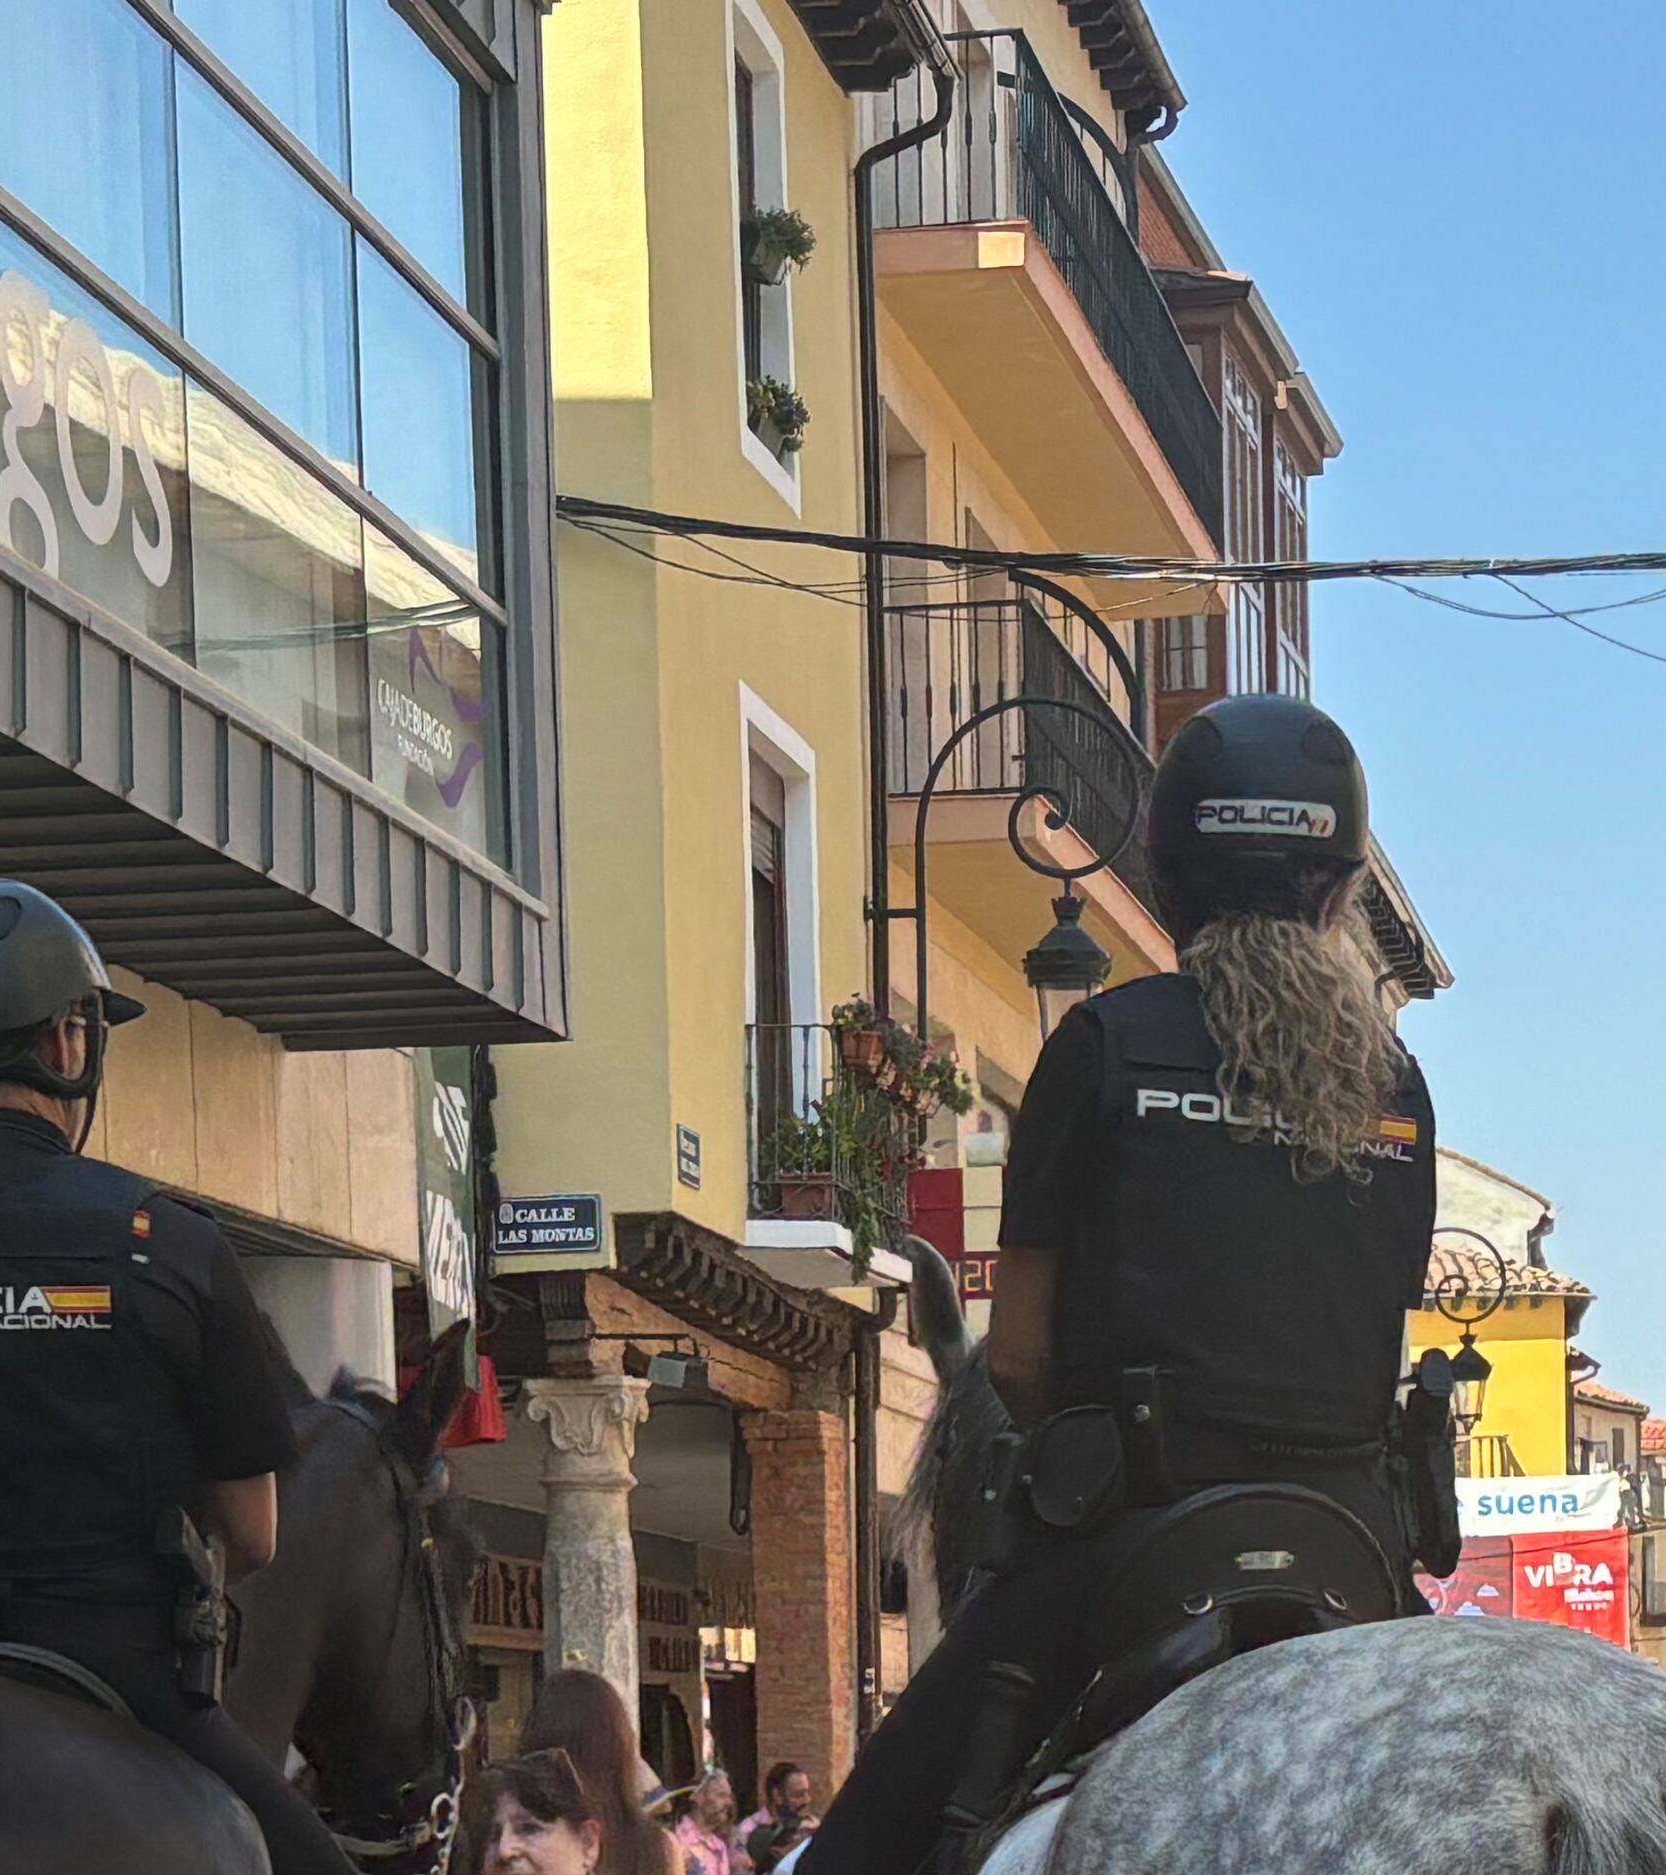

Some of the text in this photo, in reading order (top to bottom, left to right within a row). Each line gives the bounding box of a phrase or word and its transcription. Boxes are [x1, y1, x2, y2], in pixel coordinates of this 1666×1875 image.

[1194, 805, 1313, 834] POLICIA
[515, 1207, 575, 1223] CALLE
[498, 1227, 595, 1244] LAS MONTAS
[1477, 1492, 1579, 1517] suena
[1524, 1551, 1614, 1589] VIBRA
